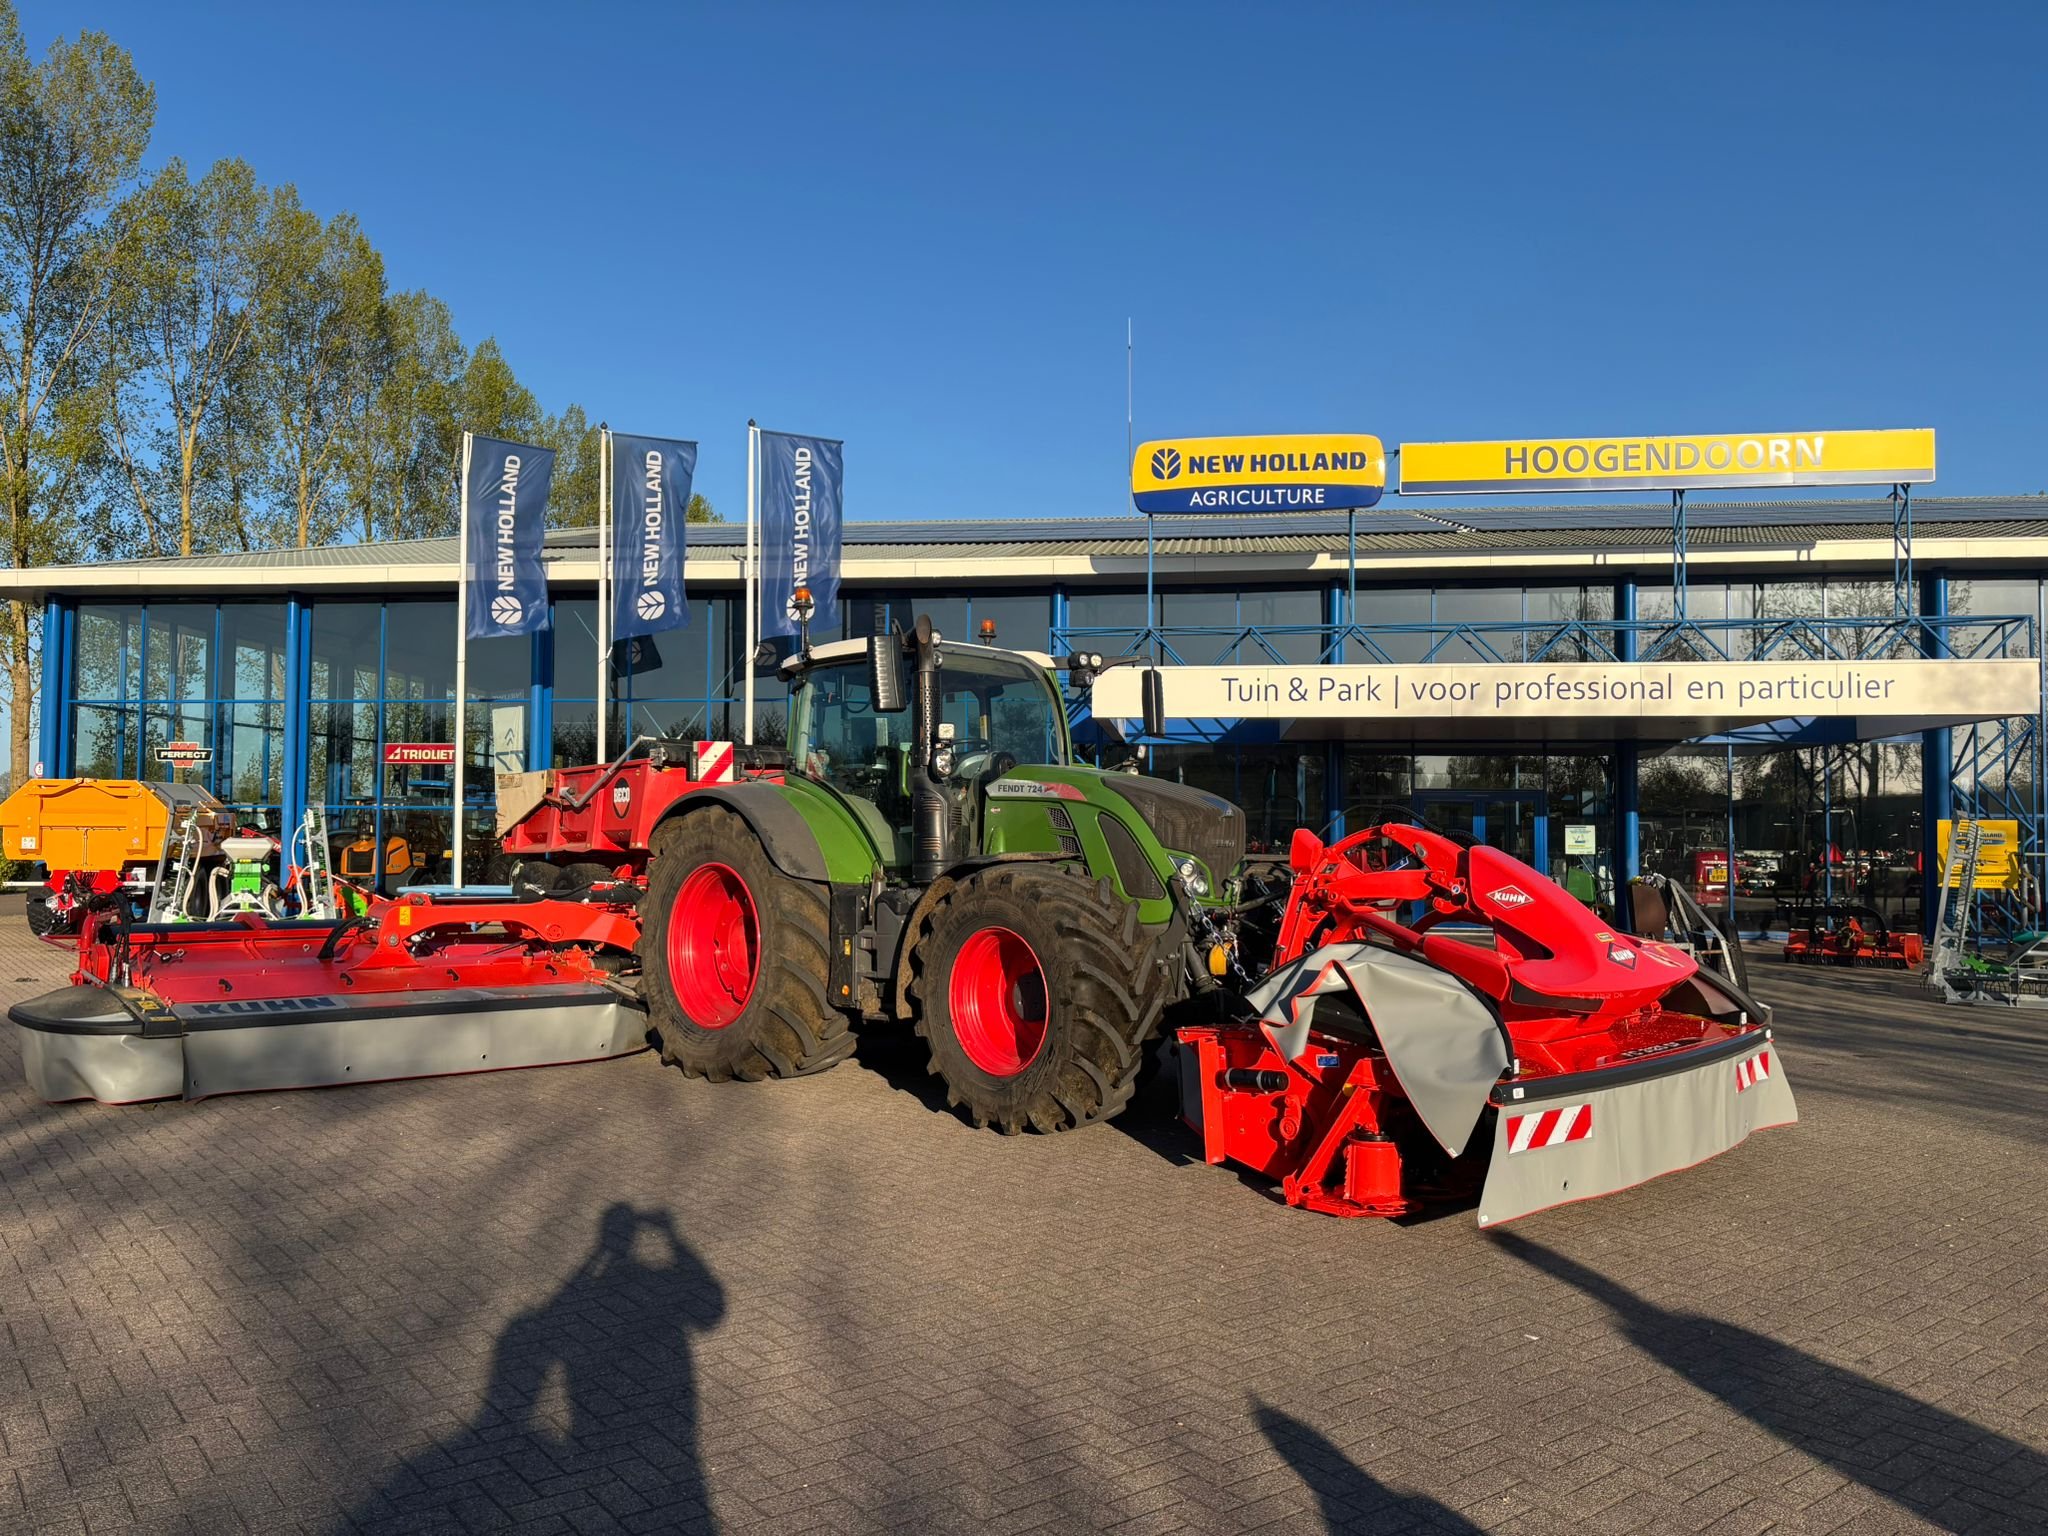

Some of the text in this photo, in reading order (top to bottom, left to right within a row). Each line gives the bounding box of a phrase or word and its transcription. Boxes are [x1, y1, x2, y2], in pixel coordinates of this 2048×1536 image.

[1188, 451, 1367, 474] NEW HOLLAND
[1505, 436, 1825, 475] HOOGENDOORN
[1189, 488, 1326, 507] AGRICULTURE
[497, 454, 521, 591] NEW HOLLAND
[643, 450, 663, 587] NEW HOLLAND
[793, 447, 812, 588] NEW HOLLAND
[1221, 677, 1279, 702] Tuin
[1288, 677, 1308, 702] &
[1318, 676, 1381, 702] Park
[1411, 679, 1481, 702] voor
[1496, 672, 1672, 709] professional
[1687, 678, 1724, 700] en
[1738, 671, 1895, 707] particulier
[160, 751, 208, 759] PERFECT
[402, 749, 455, 760] TRIOLIET
[998, 784, 1024, 793] FENDT
[1027, 785, 1043, 793] 724
[1494, 891, 1525, 904] KUHN
[1610, 949, 1636, 962] KUHN
[191, 997, 337, 1015] KUHN
